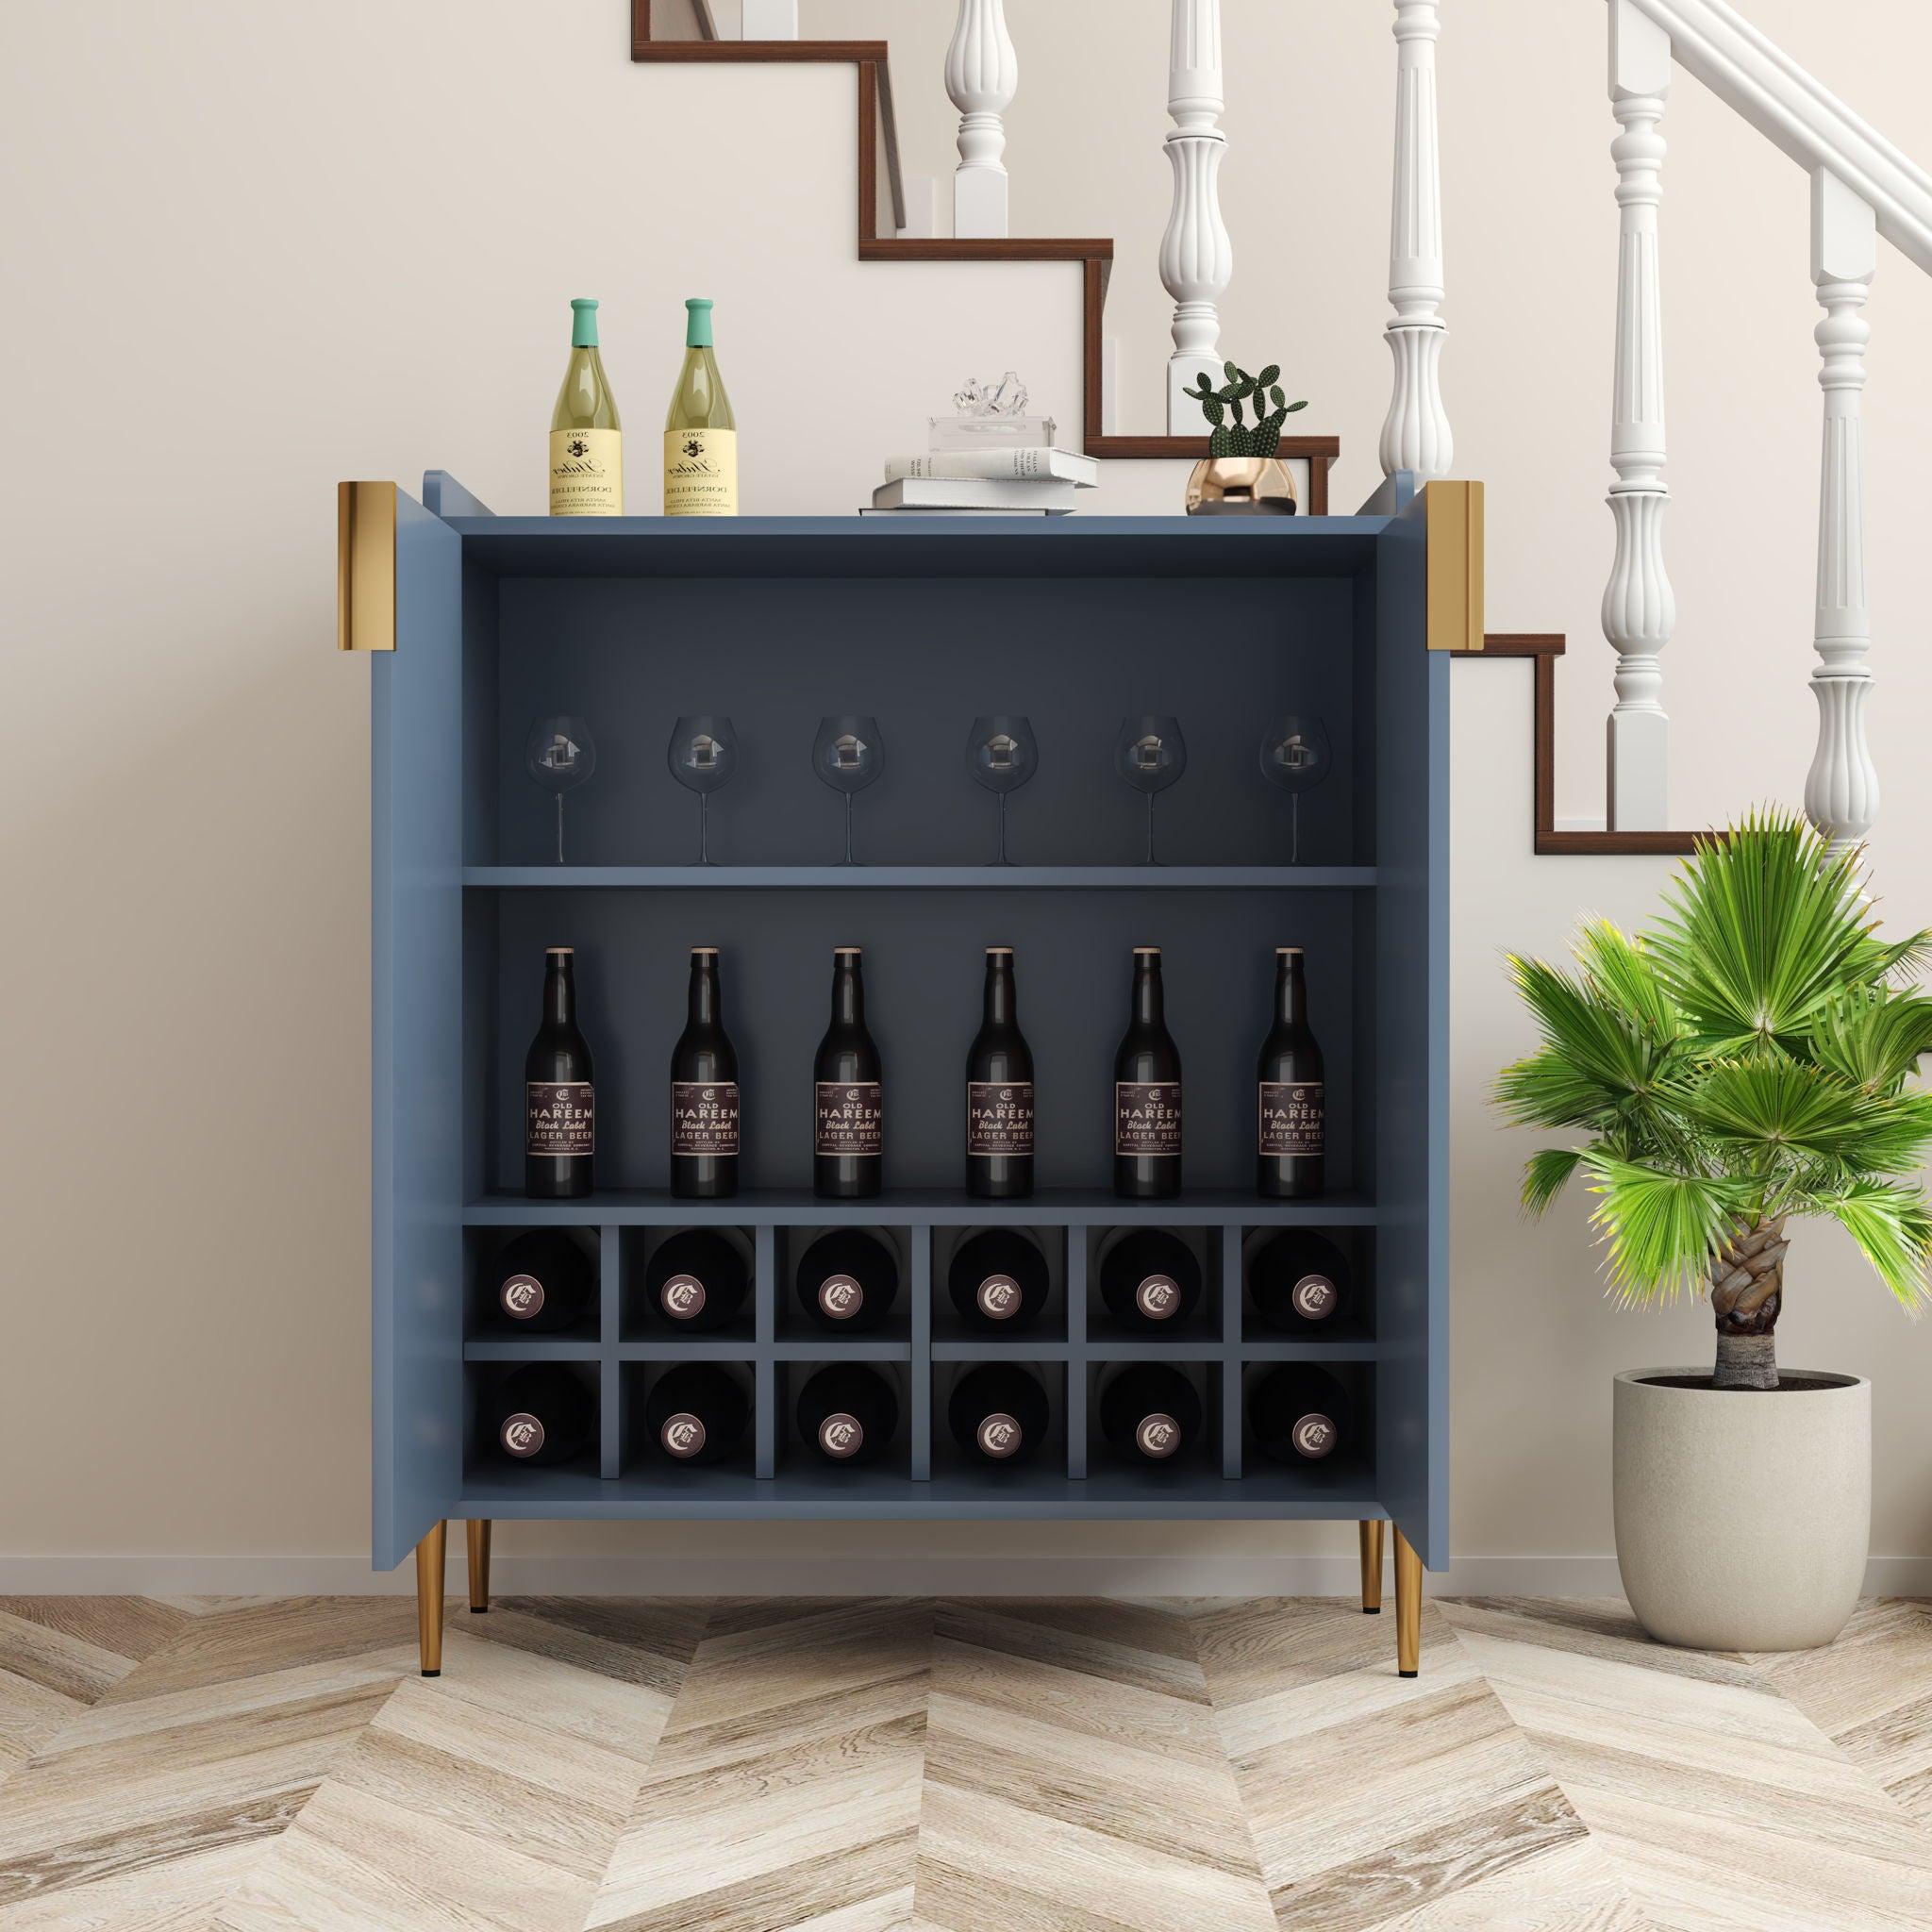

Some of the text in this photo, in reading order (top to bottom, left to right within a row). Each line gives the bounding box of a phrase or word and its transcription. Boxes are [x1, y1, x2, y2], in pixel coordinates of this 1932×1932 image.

[530, 1109, 591, 1118] HAREEM
[676, 1109, 737, 1119] HAREEM
[820, 1109, 881, 1119] HAREEM
[973, 1109, 1033, 1119] HAREEM
[536, 1120, 558, 1129] Black
[682, 1120, 705, 1129] Black
[826, 1120, 849, 1129] Black
[979, 1120, 1002, 1129] Black
[1127, 1120, 1151, 1129] Black
[1271, 1120, 1295, 1129] Black
